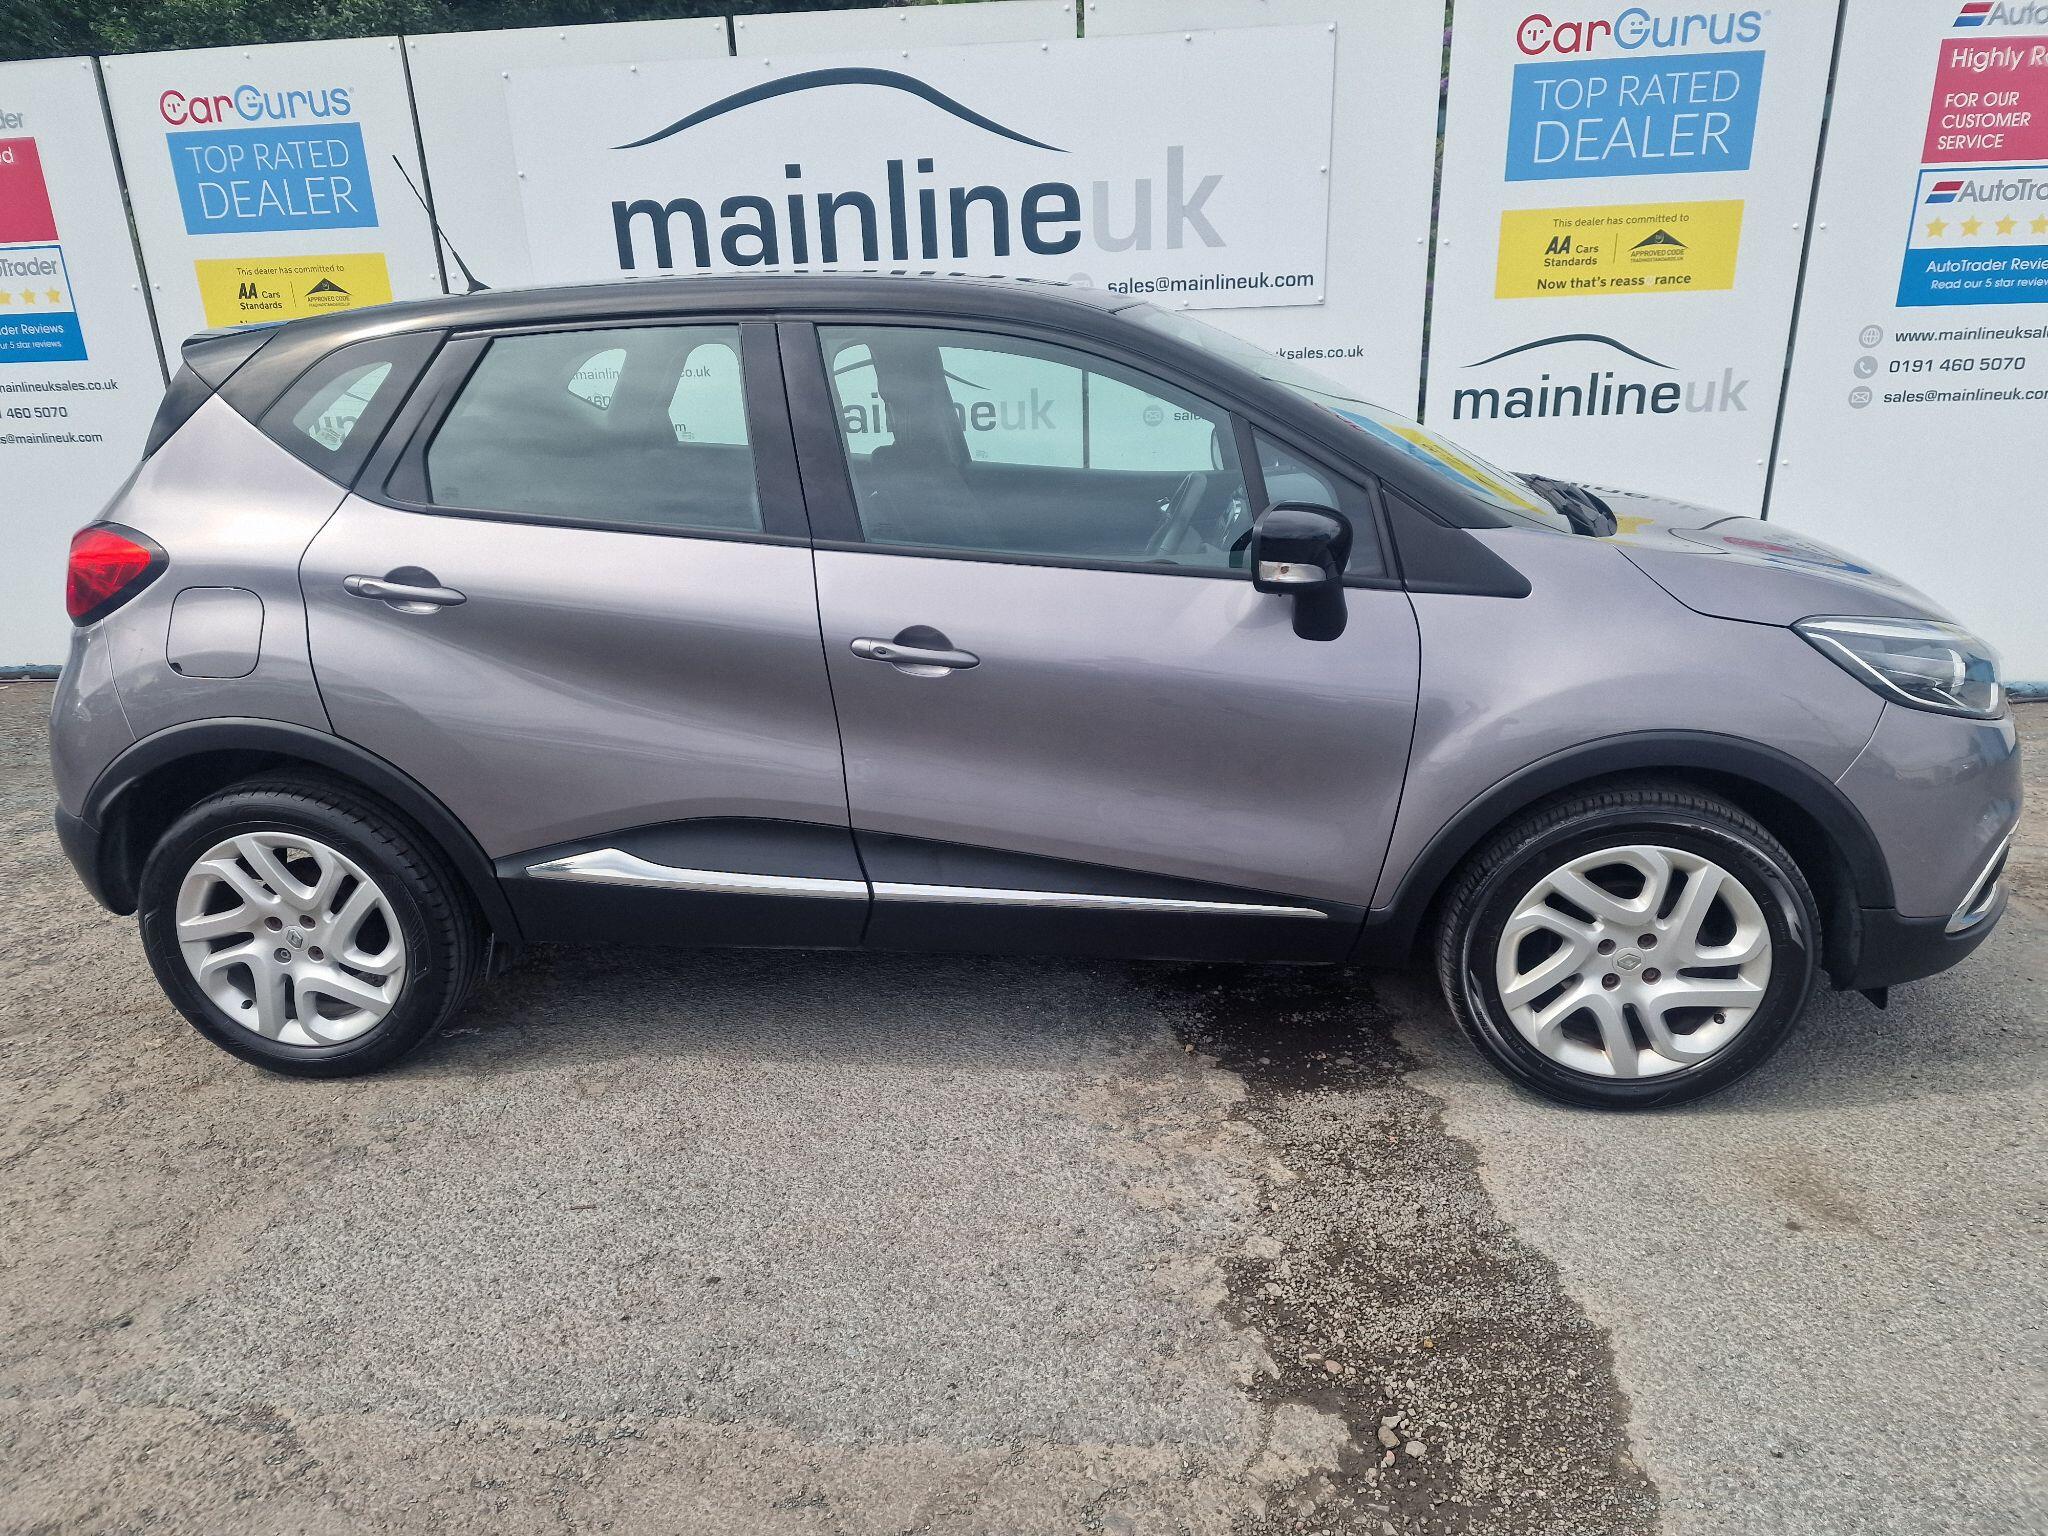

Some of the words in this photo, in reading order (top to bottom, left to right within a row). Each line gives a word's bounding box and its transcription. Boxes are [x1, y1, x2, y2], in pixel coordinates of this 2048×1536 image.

[1516, 7, 1763, 56] CarGurus
[1951, 46, 2024, 73] Highly
[2030, 45, 2048, 66] R
[1533, 77, 1608, 111] TOP
[1618, 69, 1741, 107] RATED
[160, 84, 351, 126] CarGurus
[1945, 92, 1977, 108] FOR
[1983, 91, 2020, 107] OUR
[1941, 112, 2031, 129] CUSTOMER
[1532, 111, 1732, 164] DEALER
[1937, 133, 2004, 150] SERVICE
[185, 144, 244, 174] TOP
[253, 139, 350, 171] RATED
[198, 176, 359, 220] DEALER
[611, 145, 1228, 270] mainlineuk
[1553, 218, 1573, 228] This
[1575, 217, 1605, 227] dealer
[1606, 216, 1624, 225] has
[1626, 214, 1677, 225] committed
[1679, 213, 1690, 222] to
[1544, 234, 1572, 255] AA
[1575, 244, 1599, 254] Cars
[1630, 249, 1667, 258] APPROVED
[1666, 248, 1685, 256] CODE
[0, 256, 57, 277] Trader
[236, 267, 253, 276] This
[253, 266, 277, 276] dealer
[278, 265, 293, 274] has
[293, 264, 335, 274] committed
[336, 264, 345, 272] to
[1544, 256, 1598, 268] Standards
[1926, 258, 2008, 273] AutoTrader
[238, 282, 258, 299] AA
[261, 290, 281, 299] Cars
[1107, 271, 1314, 294] sales@mainlineuk.com
[1537, 278, 1567, 290] Now
[1570, 276, 1607, 288] that's
[1610, 274, 1692, 287] reassrance
[1930, 278, 1961, 290] Read
[1963, 280, 1983, 289] our
[1985, 278, 1992, 288] 5
[1994, 277, 2016, 288] star
[239, 301, 283, 311] Standards
[20, 323, 64, 335] Reviews
[1895, 325, 2048, 342] www.mainlineuksal
[10, 341, 15, 349] 5
[1275, 344, 1364, 360] ksales.co.uk
[1889, 359, 1933, 374] 0191
[1939, 358, 1975, 373] 460
[1979, 356, 2026, 371] 5070
[1452, 367, 1751, 420] mainlineuk
[6, 407, 32, 419] 460
[33, 406, 68, 418] 5070
